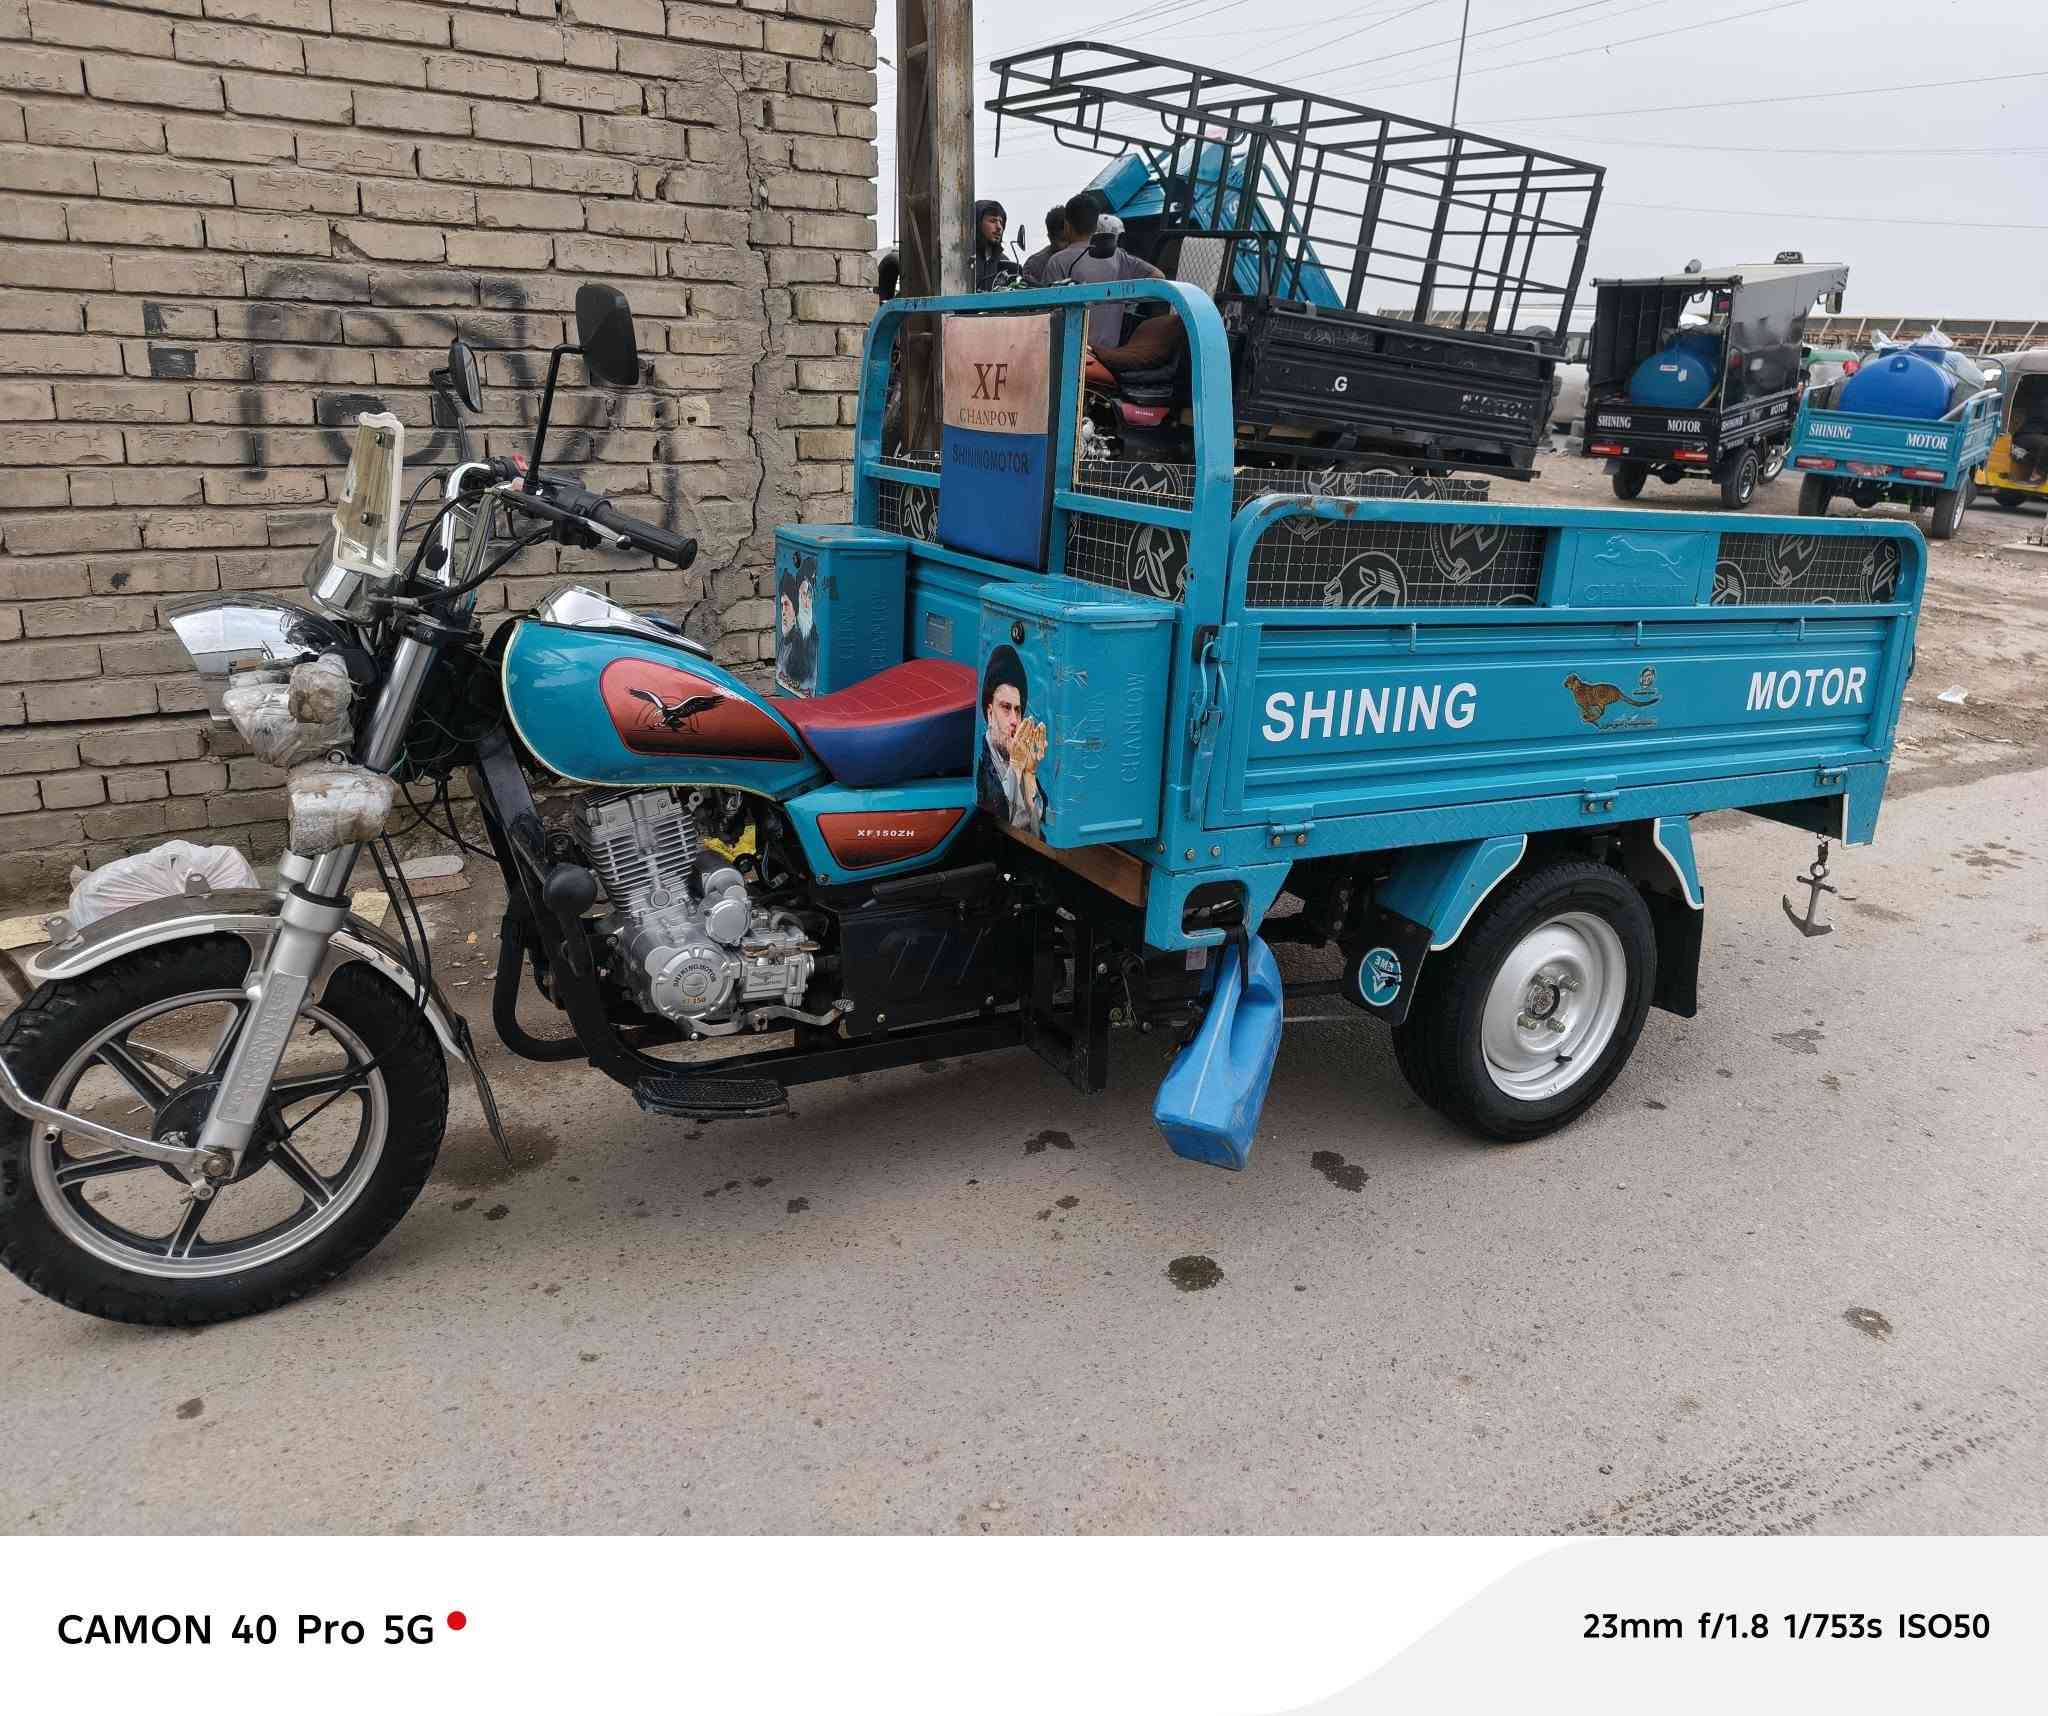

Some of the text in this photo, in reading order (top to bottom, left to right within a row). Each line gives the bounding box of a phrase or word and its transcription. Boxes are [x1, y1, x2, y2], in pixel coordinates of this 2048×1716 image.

[971, 363, 1008, 400] XF
[959, 408, 1018, 428] CHANPOW
[1597, 415, 1701, 433] SHINING MOTOR
[1809, 423, 1948, 450] SHINING MOTOR
[1262, 667, 1867, 742] SHINING MOTOR
[857, 829, 915, 838] XF150ZH
